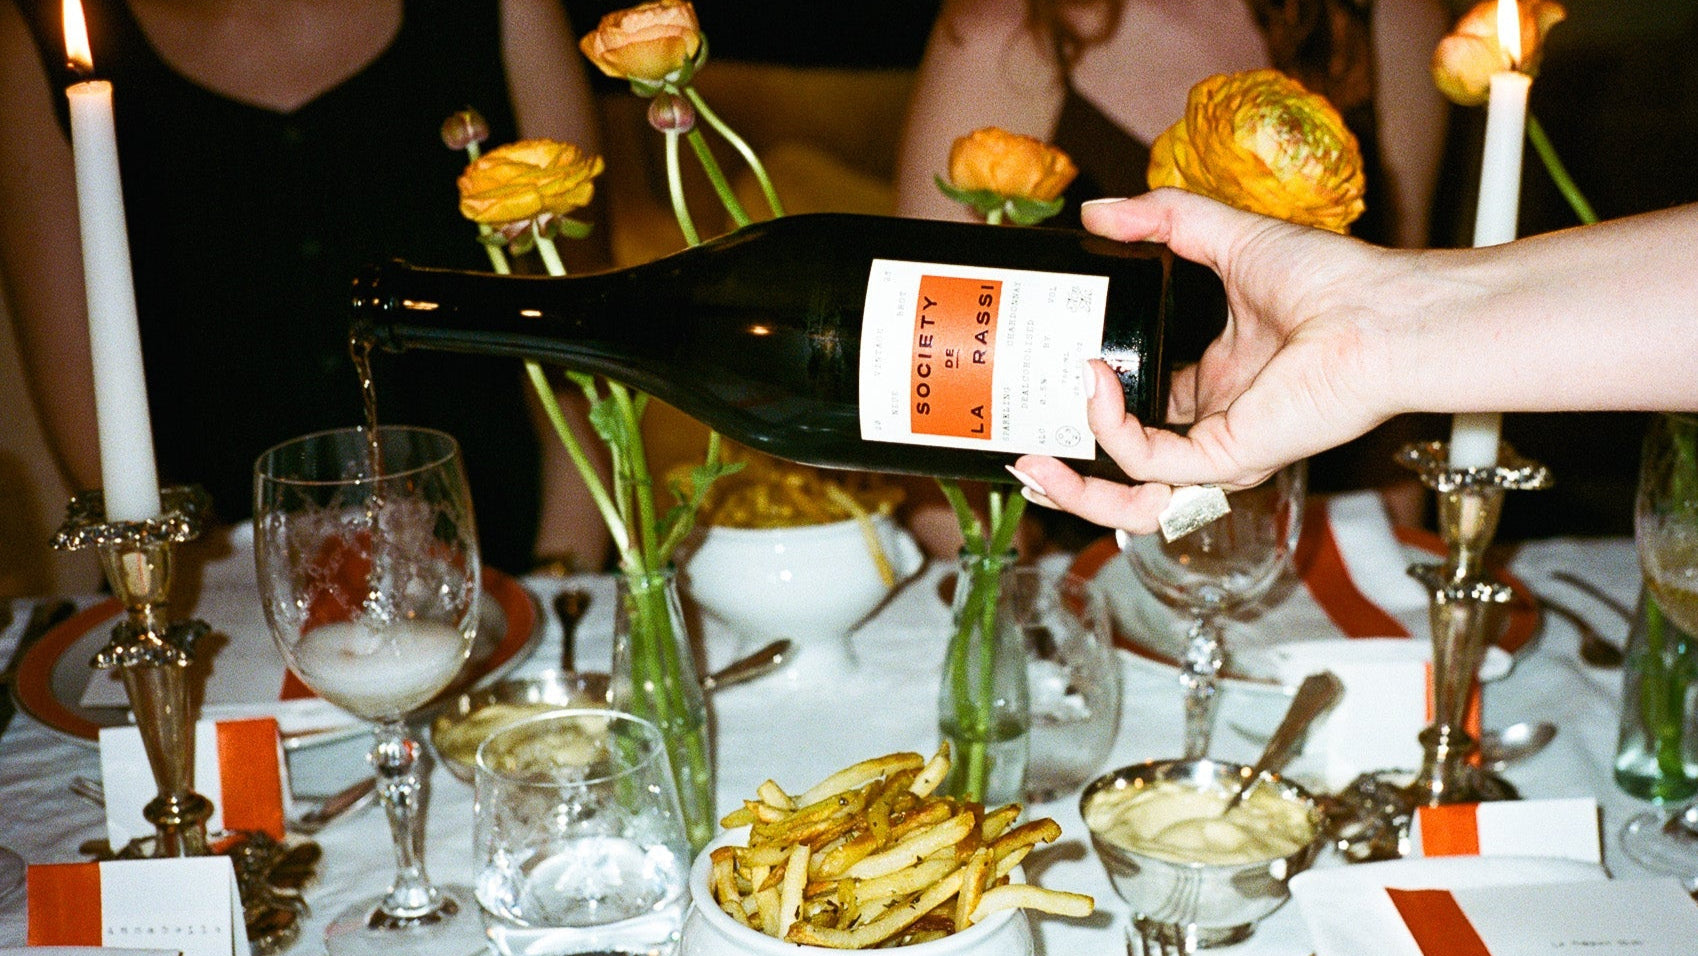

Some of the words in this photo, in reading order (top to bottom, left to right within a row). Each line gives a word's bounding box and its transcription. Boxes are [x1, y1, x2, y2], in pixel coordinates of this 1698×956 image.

[916, 296, 938, 415] SOCIETY
[972, 284, 995, 365] RASSI
[1043, 335, 1051, 348] BY
[1048, 285, 1058, 304] VOL
[945, 348, 955, 368] DE
[1002, 386, 1011, 441] SPARKLING
[1007, 280, 1022, 346] CHARDONNAY
[1021, 318, 1035, 409] DEALCOHOLISED
[971, 404, 984, 434] LA
